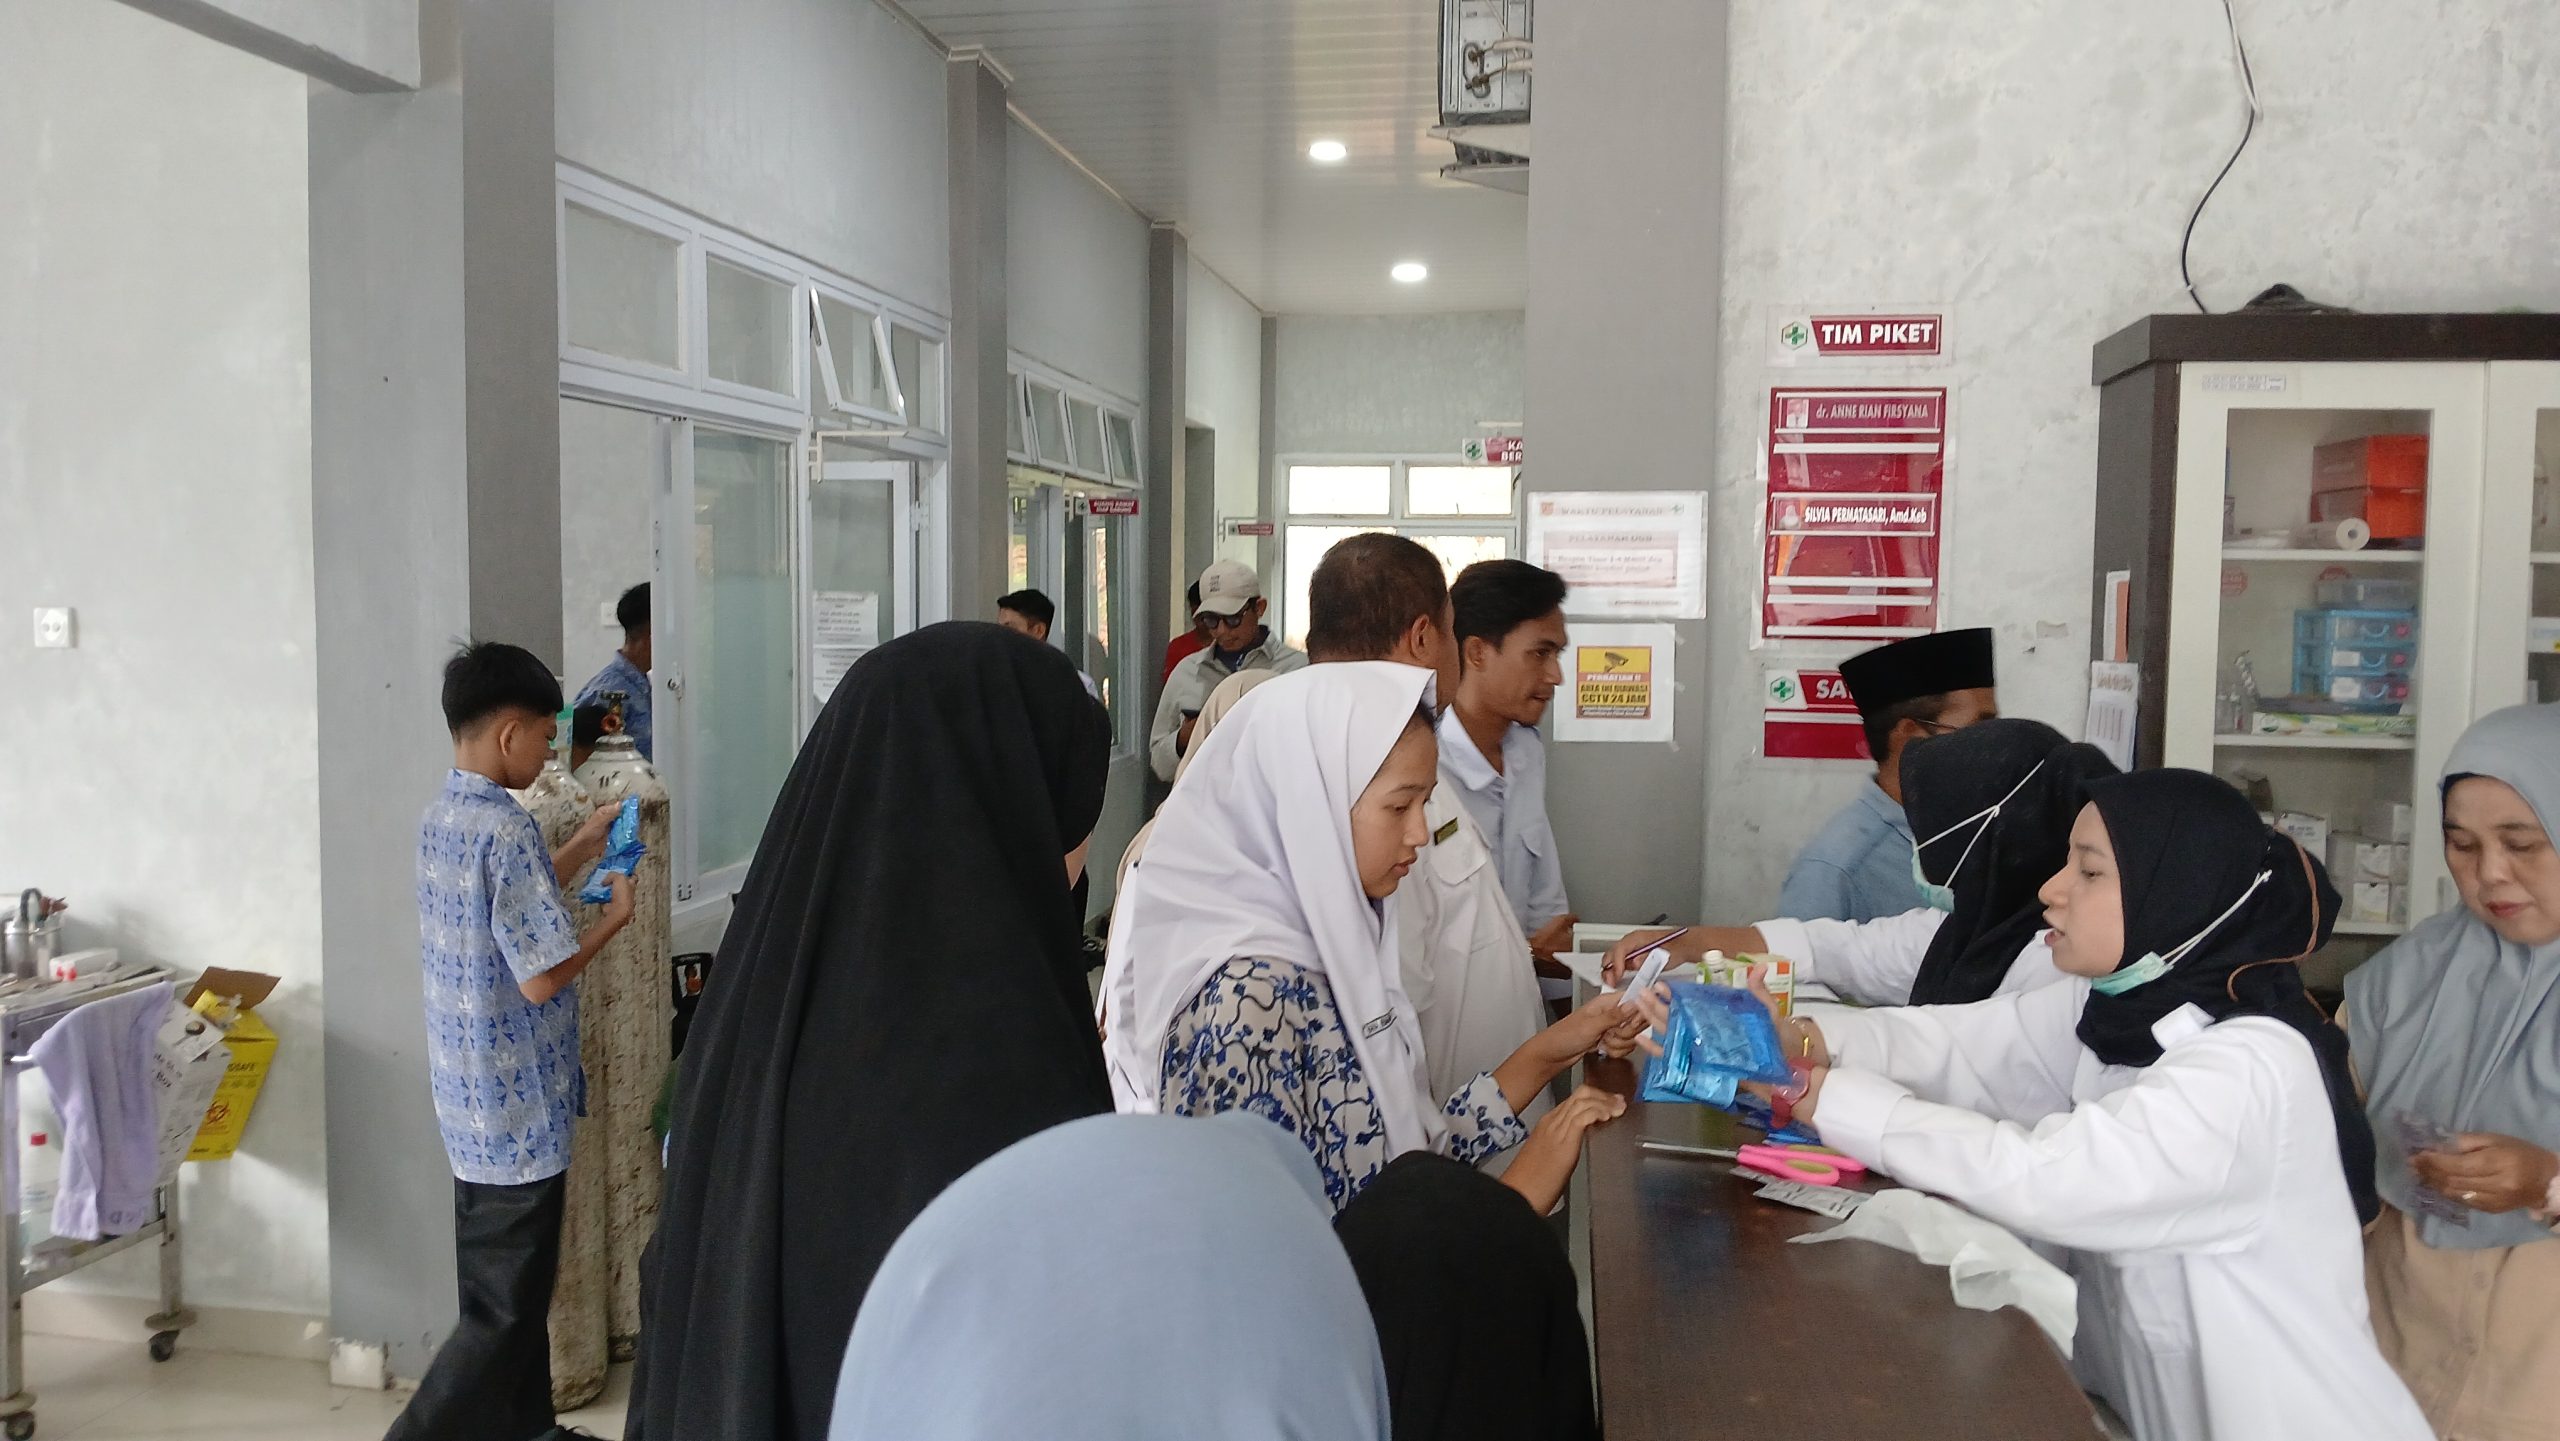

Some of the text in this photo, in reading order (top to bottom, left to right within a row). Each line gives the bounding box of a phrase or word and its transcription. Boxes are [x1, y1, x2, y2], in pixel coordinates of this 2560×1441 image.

[1821, 323, 1934, 344] TIM PIKET
[1816, 404, 1929, 418] dr. ANNE RIAN FIRSYANA
[1804, 507, 1927, 525] SILVIA PERMATASARI, Amd.Keb
[1581, 694, 1647, 703] CCTV 24 JAM
[1816, 679, 1854, 700] SA
